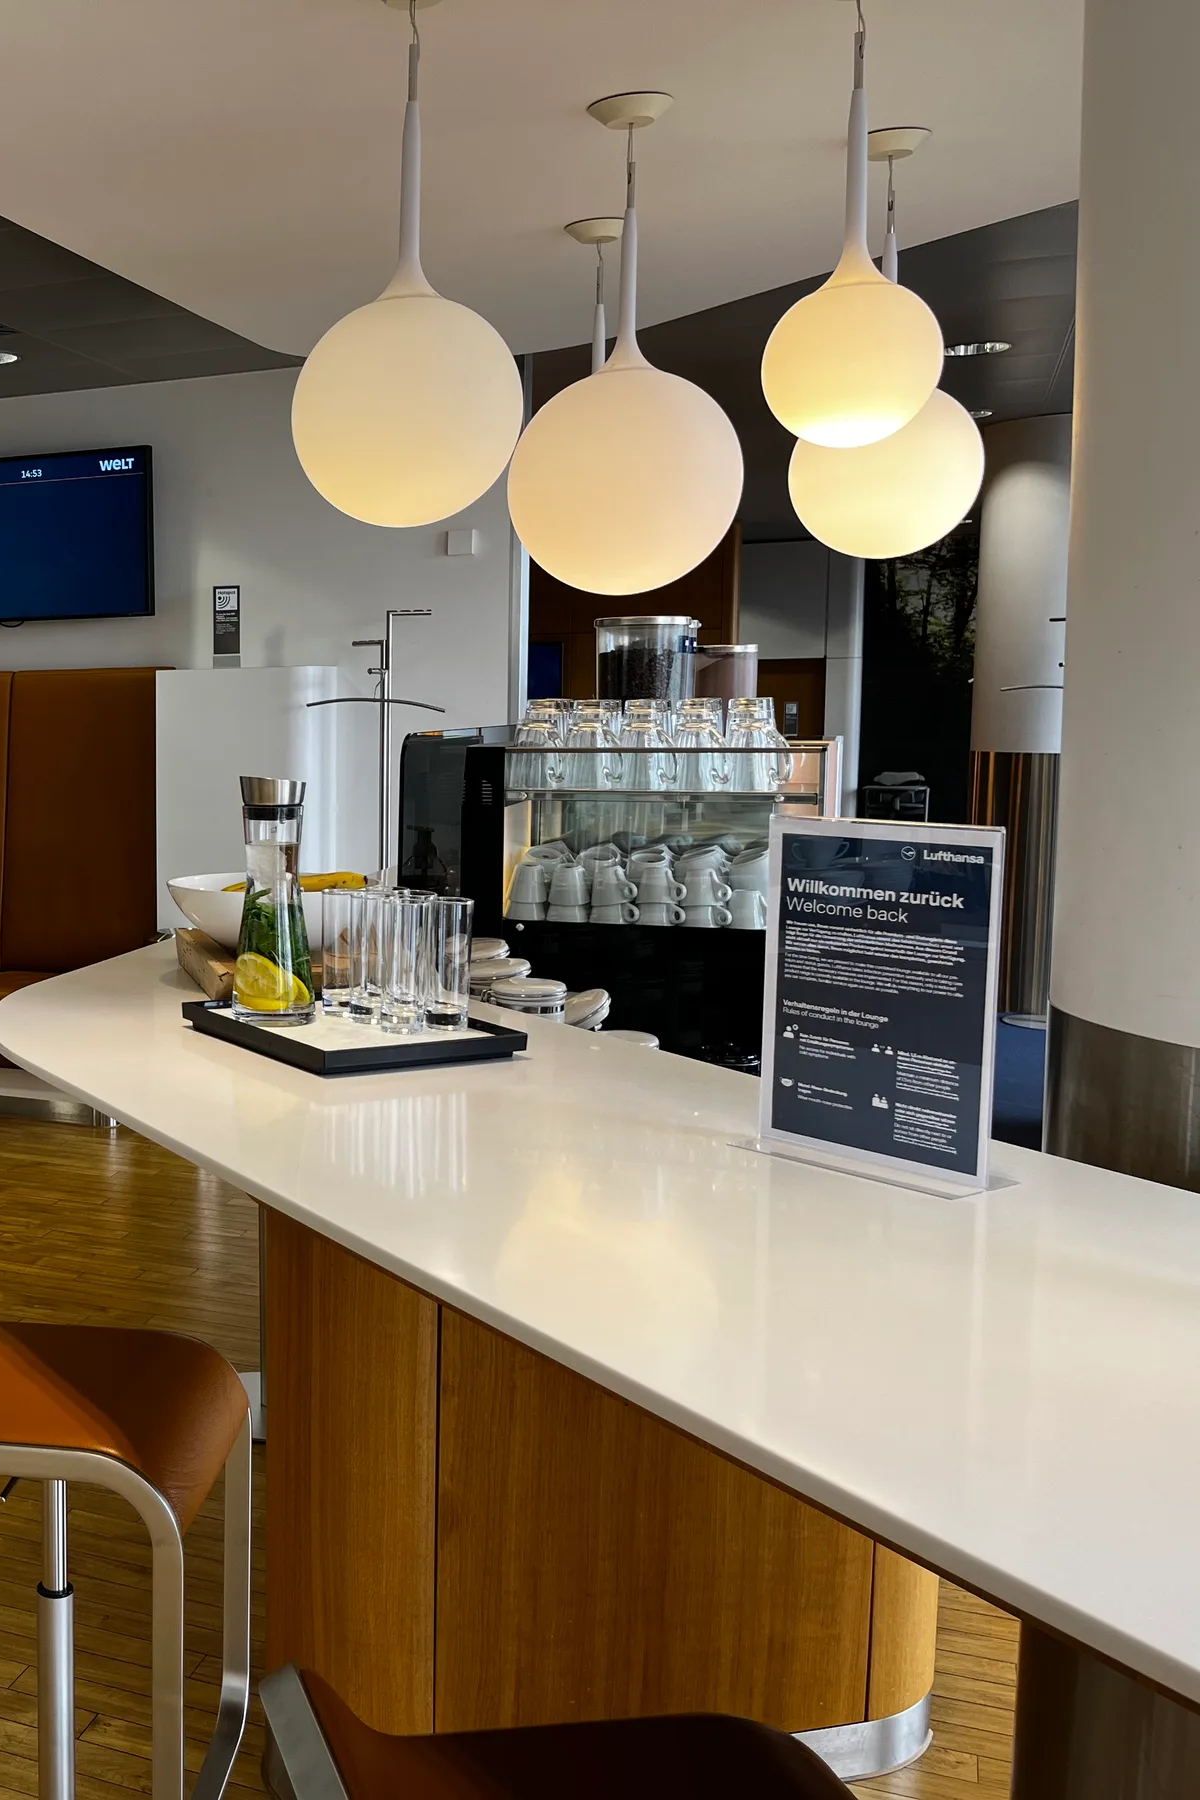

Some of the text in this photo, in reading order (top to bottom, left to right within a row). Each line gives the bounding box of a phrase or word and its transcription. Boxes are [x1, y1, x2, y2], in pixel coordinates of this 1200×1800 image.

[21, 469, 42, 478] 14:53
[923, 849, 984, 863] Lufthansa
[787, 877, 964, 909] Willkommen zurück
[786, 896, 908, 923] Welcome back
[782, 999, 839, 1015] Verhaltensregeln
[861, 1011, 888, 1023] Lounge
[782, 1006, 799, 1015] Rules
[808, 1010, 835, 1021] conduct
[855, 1018, 878, 1030] lounge
